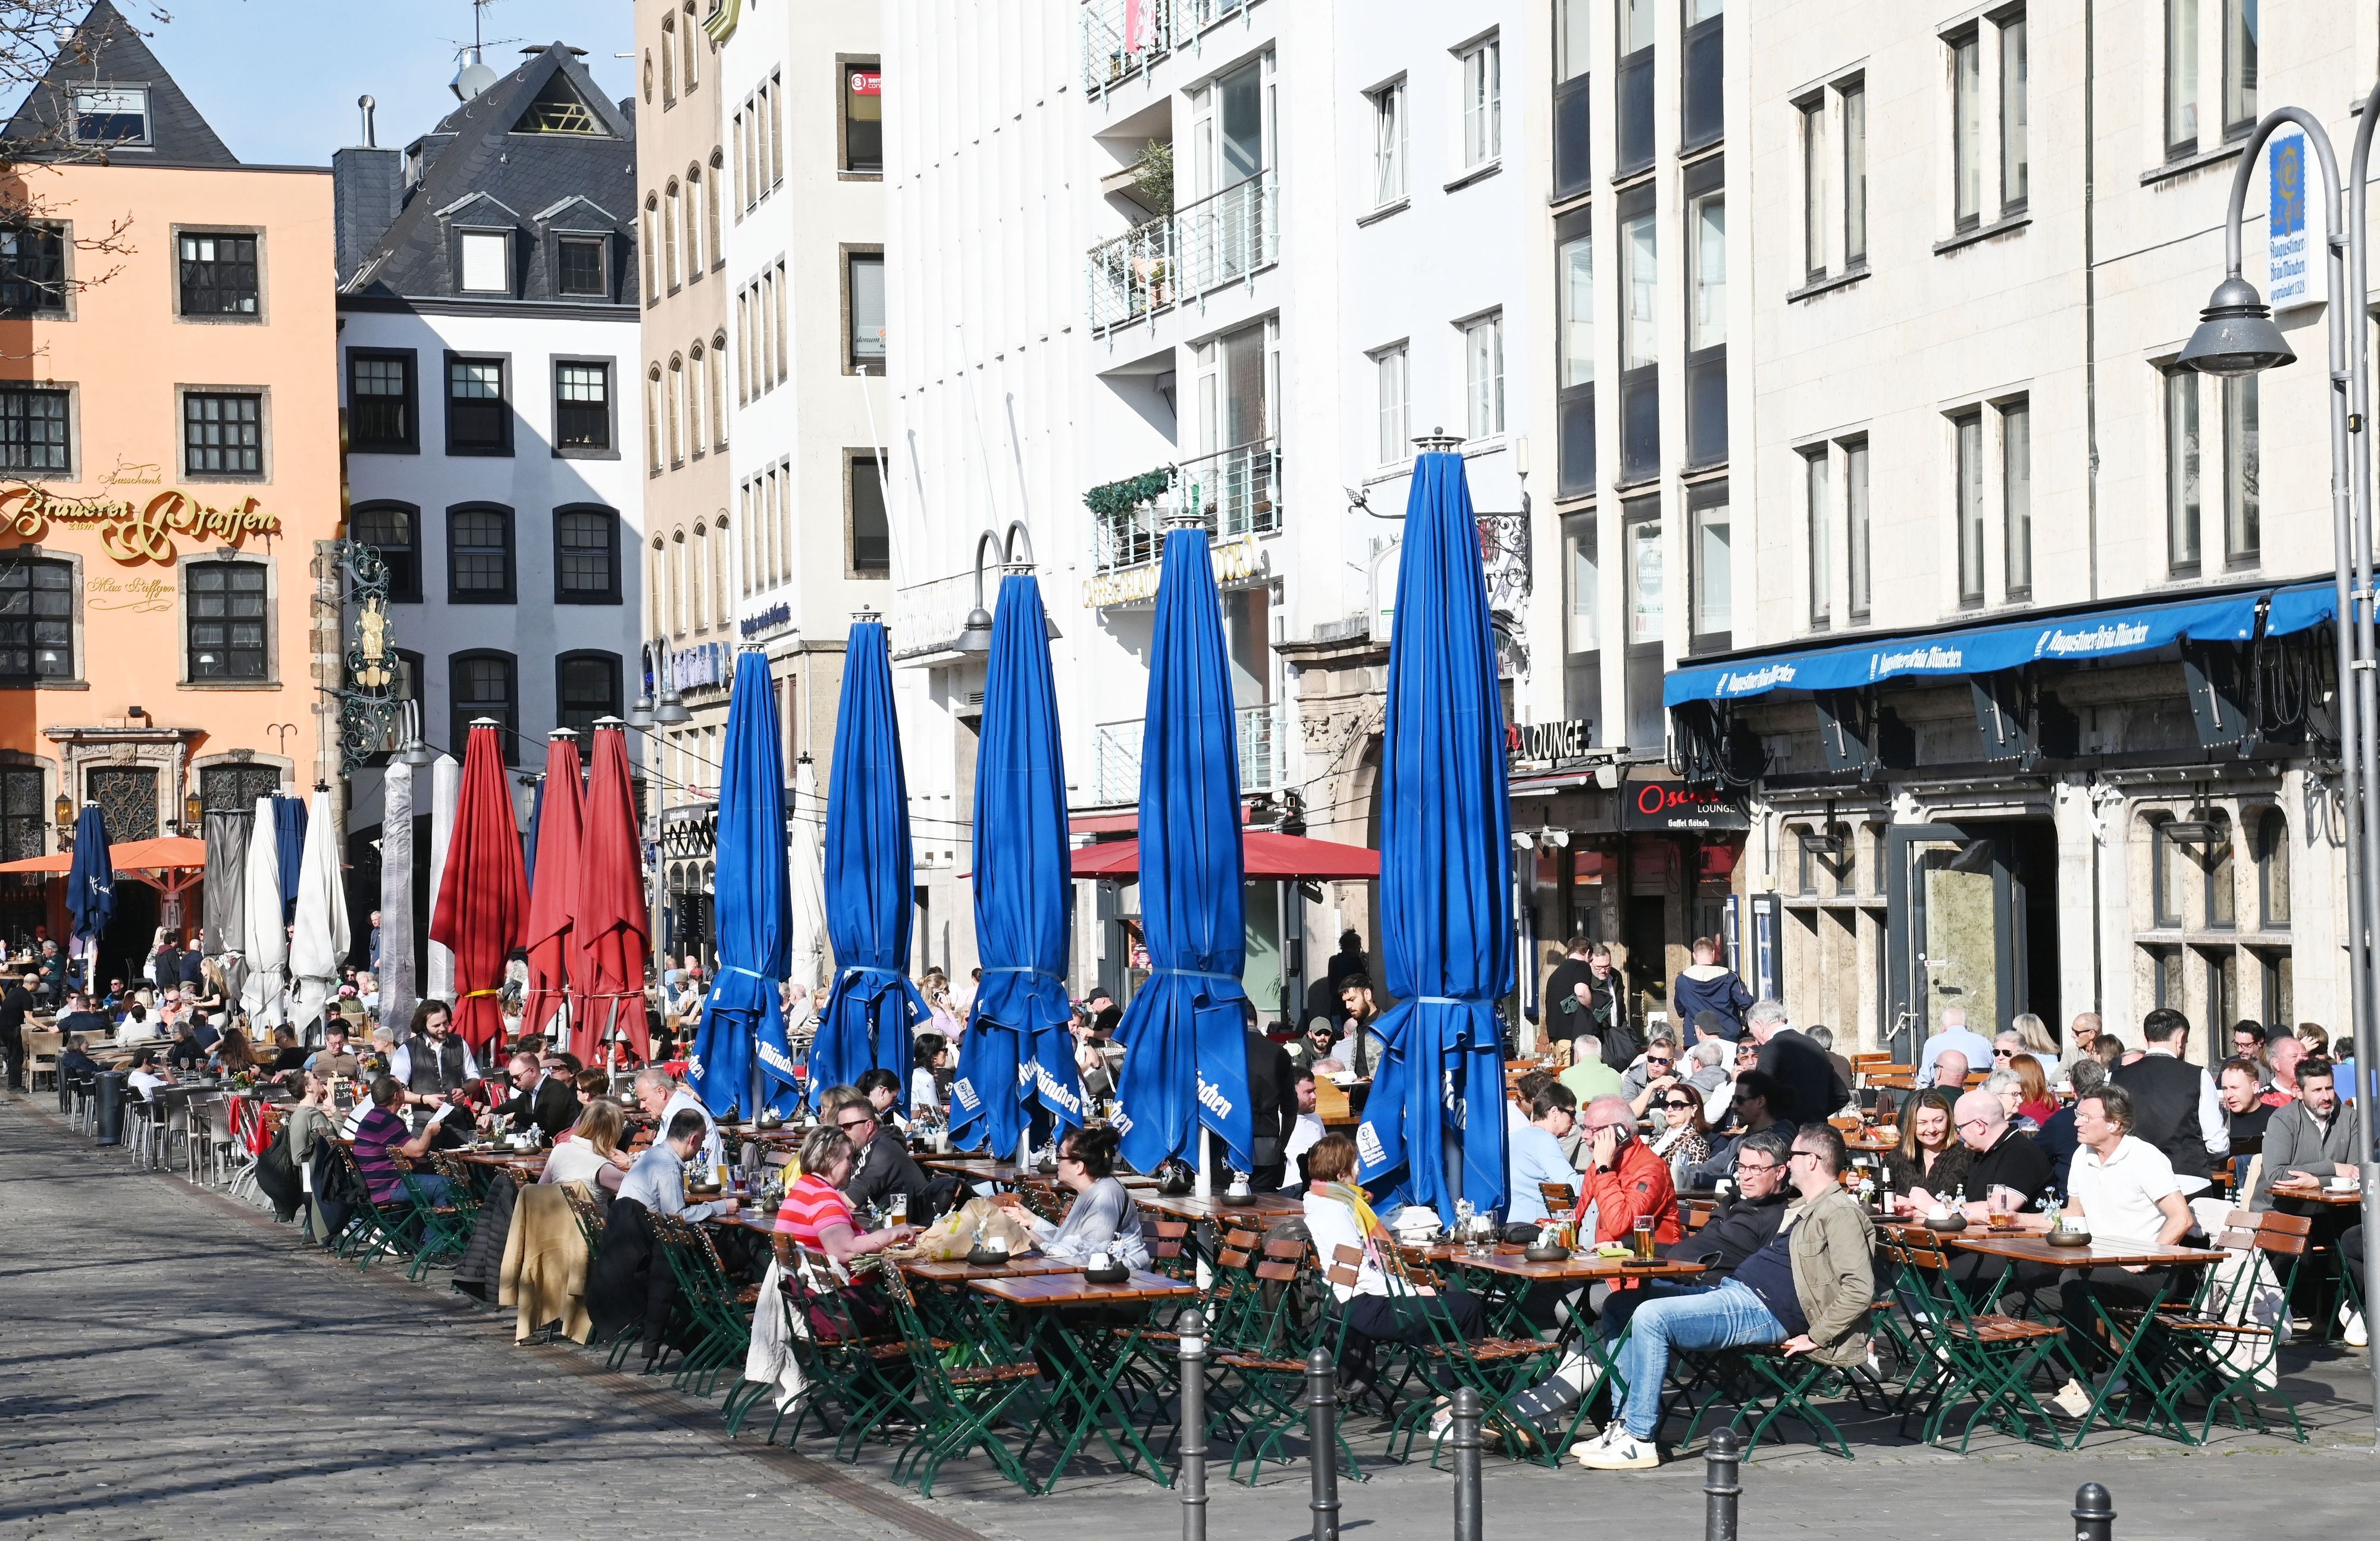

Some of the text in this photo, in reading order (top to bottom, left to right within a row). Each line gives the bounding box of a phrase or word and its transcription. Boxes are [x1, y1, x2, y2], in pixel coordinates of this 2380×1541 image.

[2294, 279, 2305, 297] 1328
[68, 522, 95, 531] zum
[100, 488, 277, 560] Pfaffen
[87, 577, 122, 593] Max
[2113, 620, 2149, 647] München
[1521, 719, 1583, 762] LOUNGE
[1698, 804, 1736, 813] LOUNGE
[1668, 818, 1709, 828] Gaffel Kölsch
